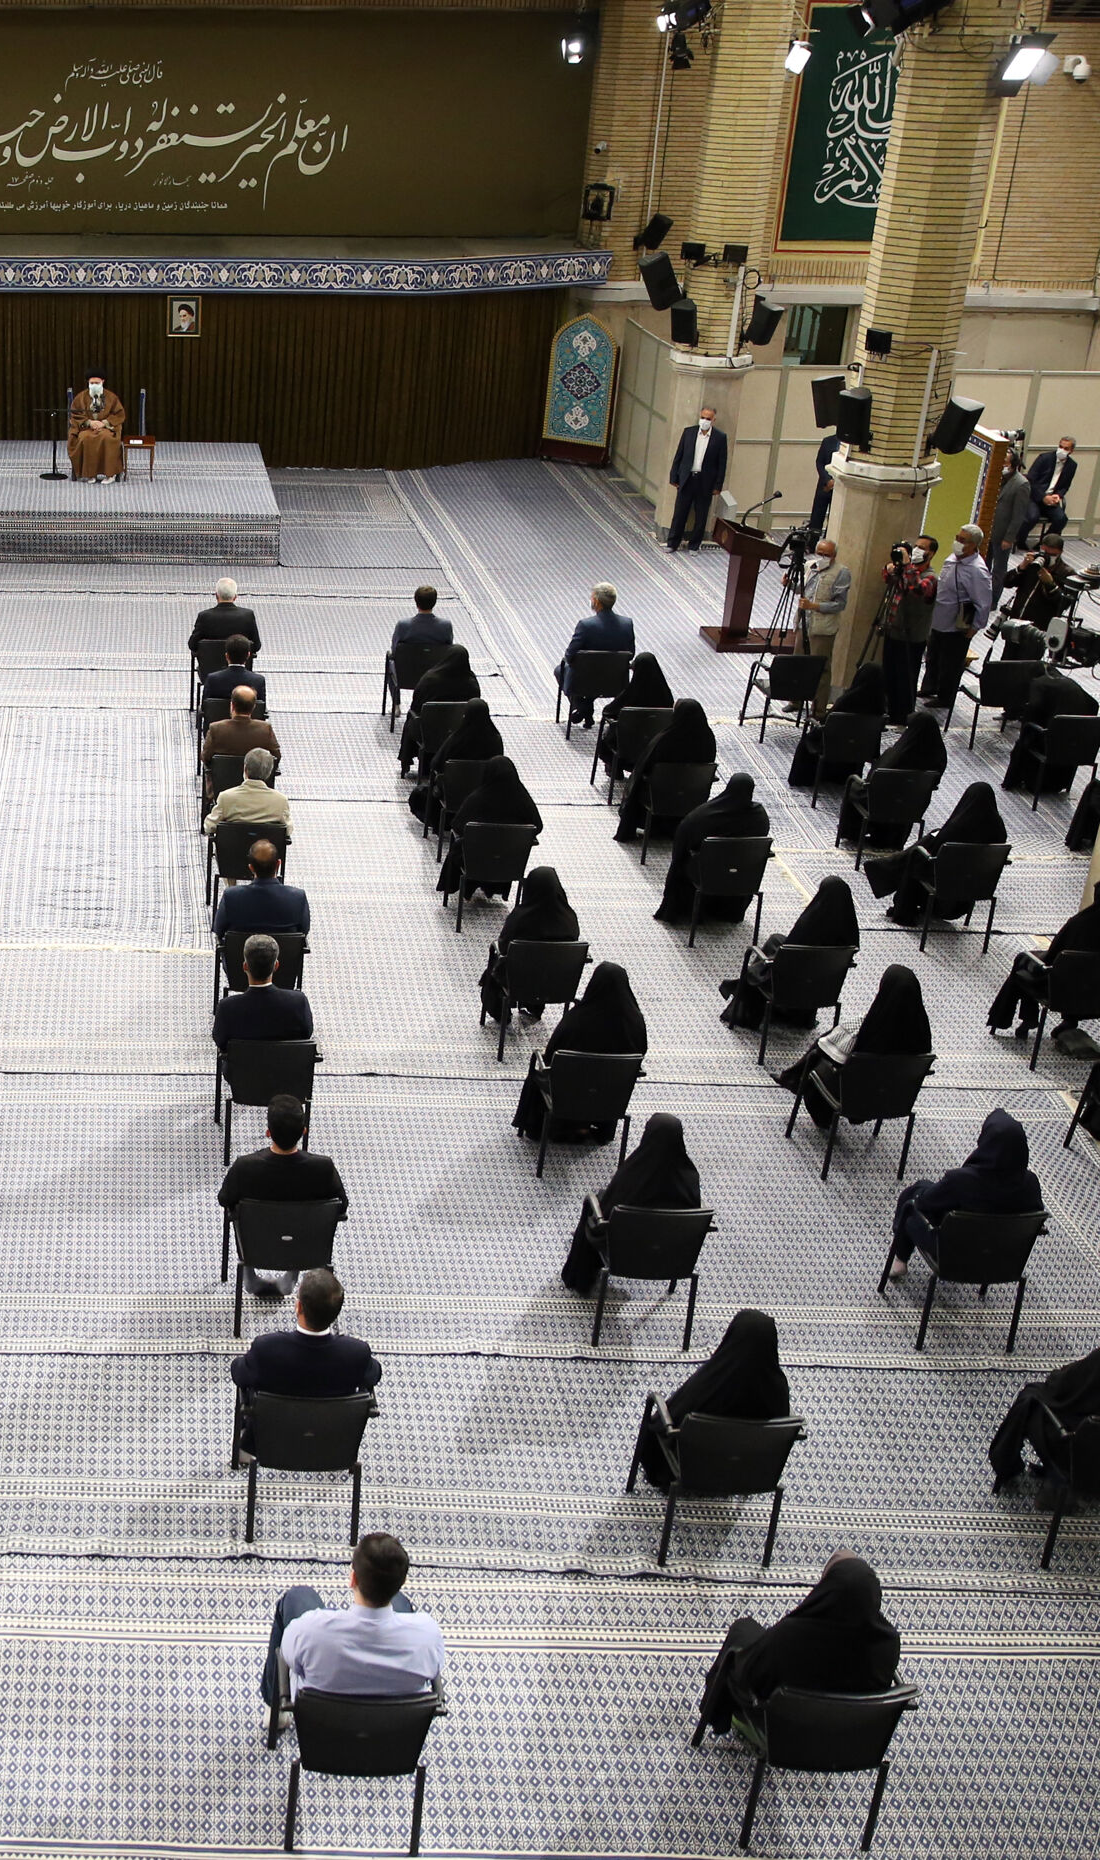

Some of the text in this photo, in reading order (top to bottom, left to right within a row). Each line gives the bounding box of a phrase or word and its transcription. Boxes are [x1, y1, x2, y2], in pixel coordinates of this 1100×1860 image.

[15, 202, 26, 211] می
[97, 200, 113, 212] برای
[133, 200, 155, 212] ماهیان
[161, 200, 177, 212] زمین
[210, 201, 228, 209] همانا
